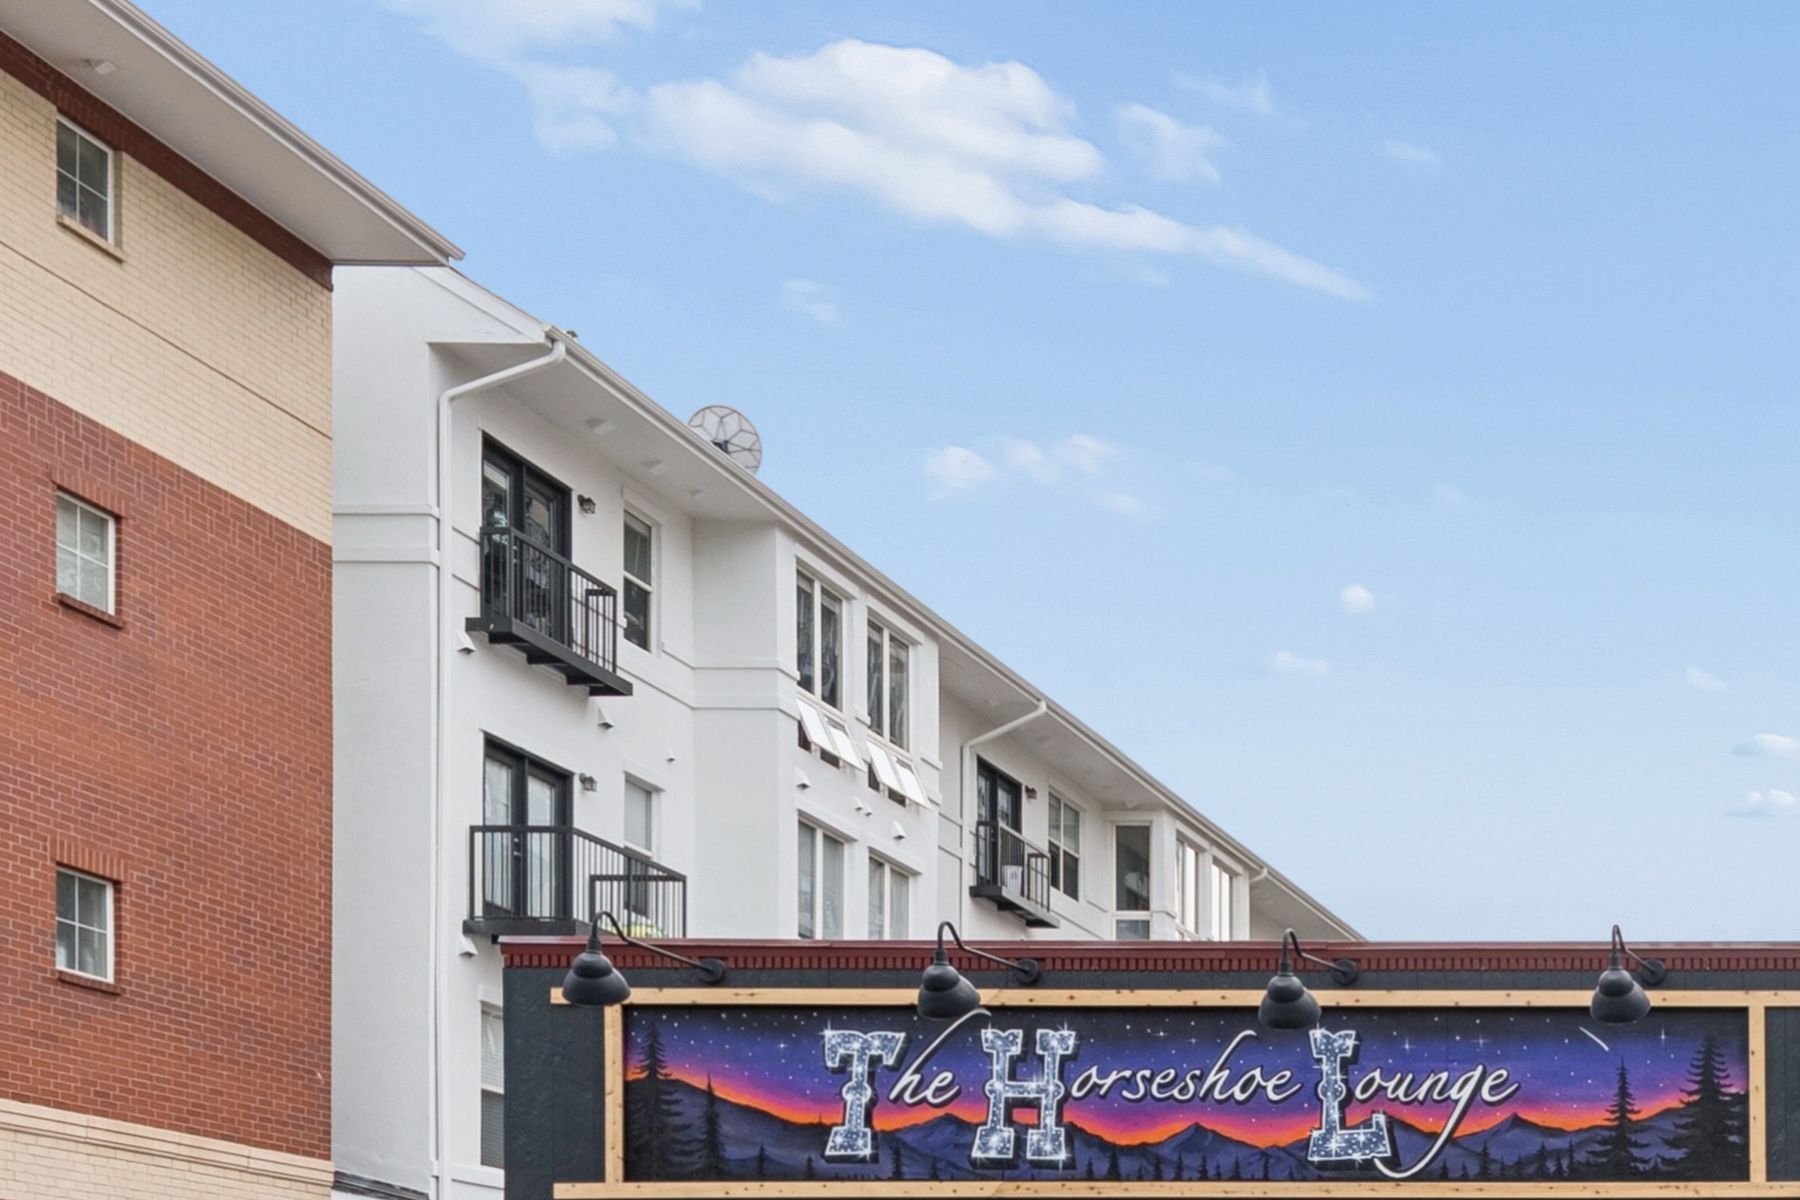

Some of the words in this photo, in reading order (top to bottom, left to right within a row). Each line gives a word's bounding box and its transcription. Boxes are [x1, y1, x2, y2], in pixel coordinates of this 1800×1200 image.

[822, 1008, 990, 1160] The
[970, 1028, 1301, 1162] Horseshoe
[1307, 1028, 1520, 1179] Lounge
